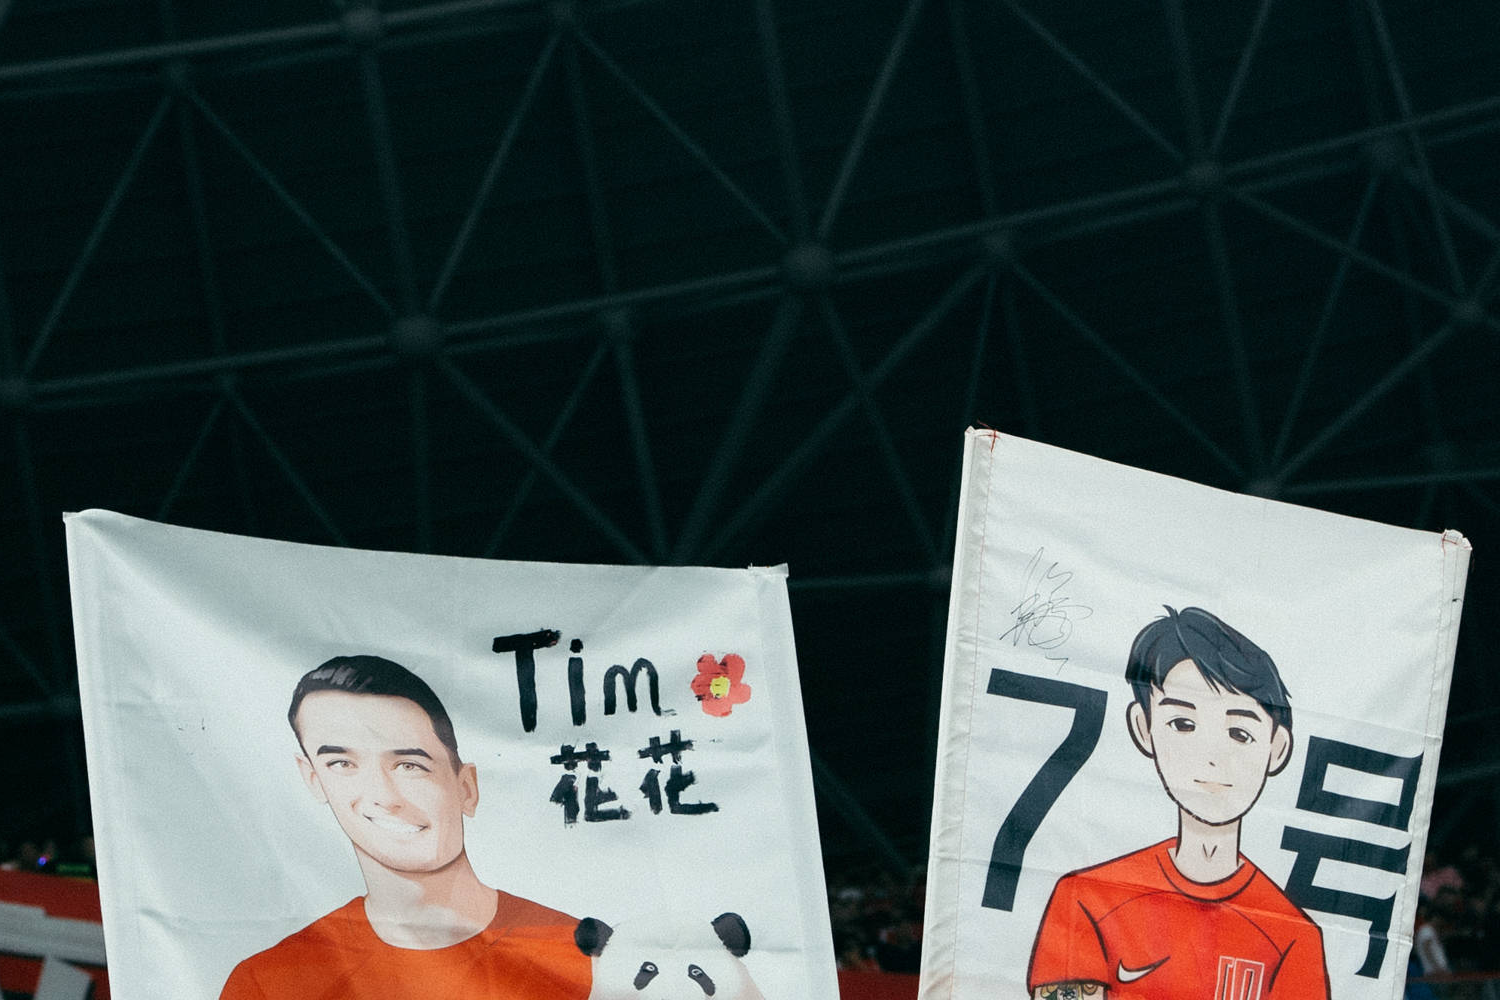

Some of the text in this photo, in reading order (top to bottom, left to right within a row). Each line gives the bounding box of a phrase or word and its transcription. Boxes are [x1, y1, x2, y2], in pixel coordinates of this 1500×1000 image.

[491, 629, 662, 732] Tim
[550, 729, 718, 824] 花花
[980, 667, 1108, 911] 7
